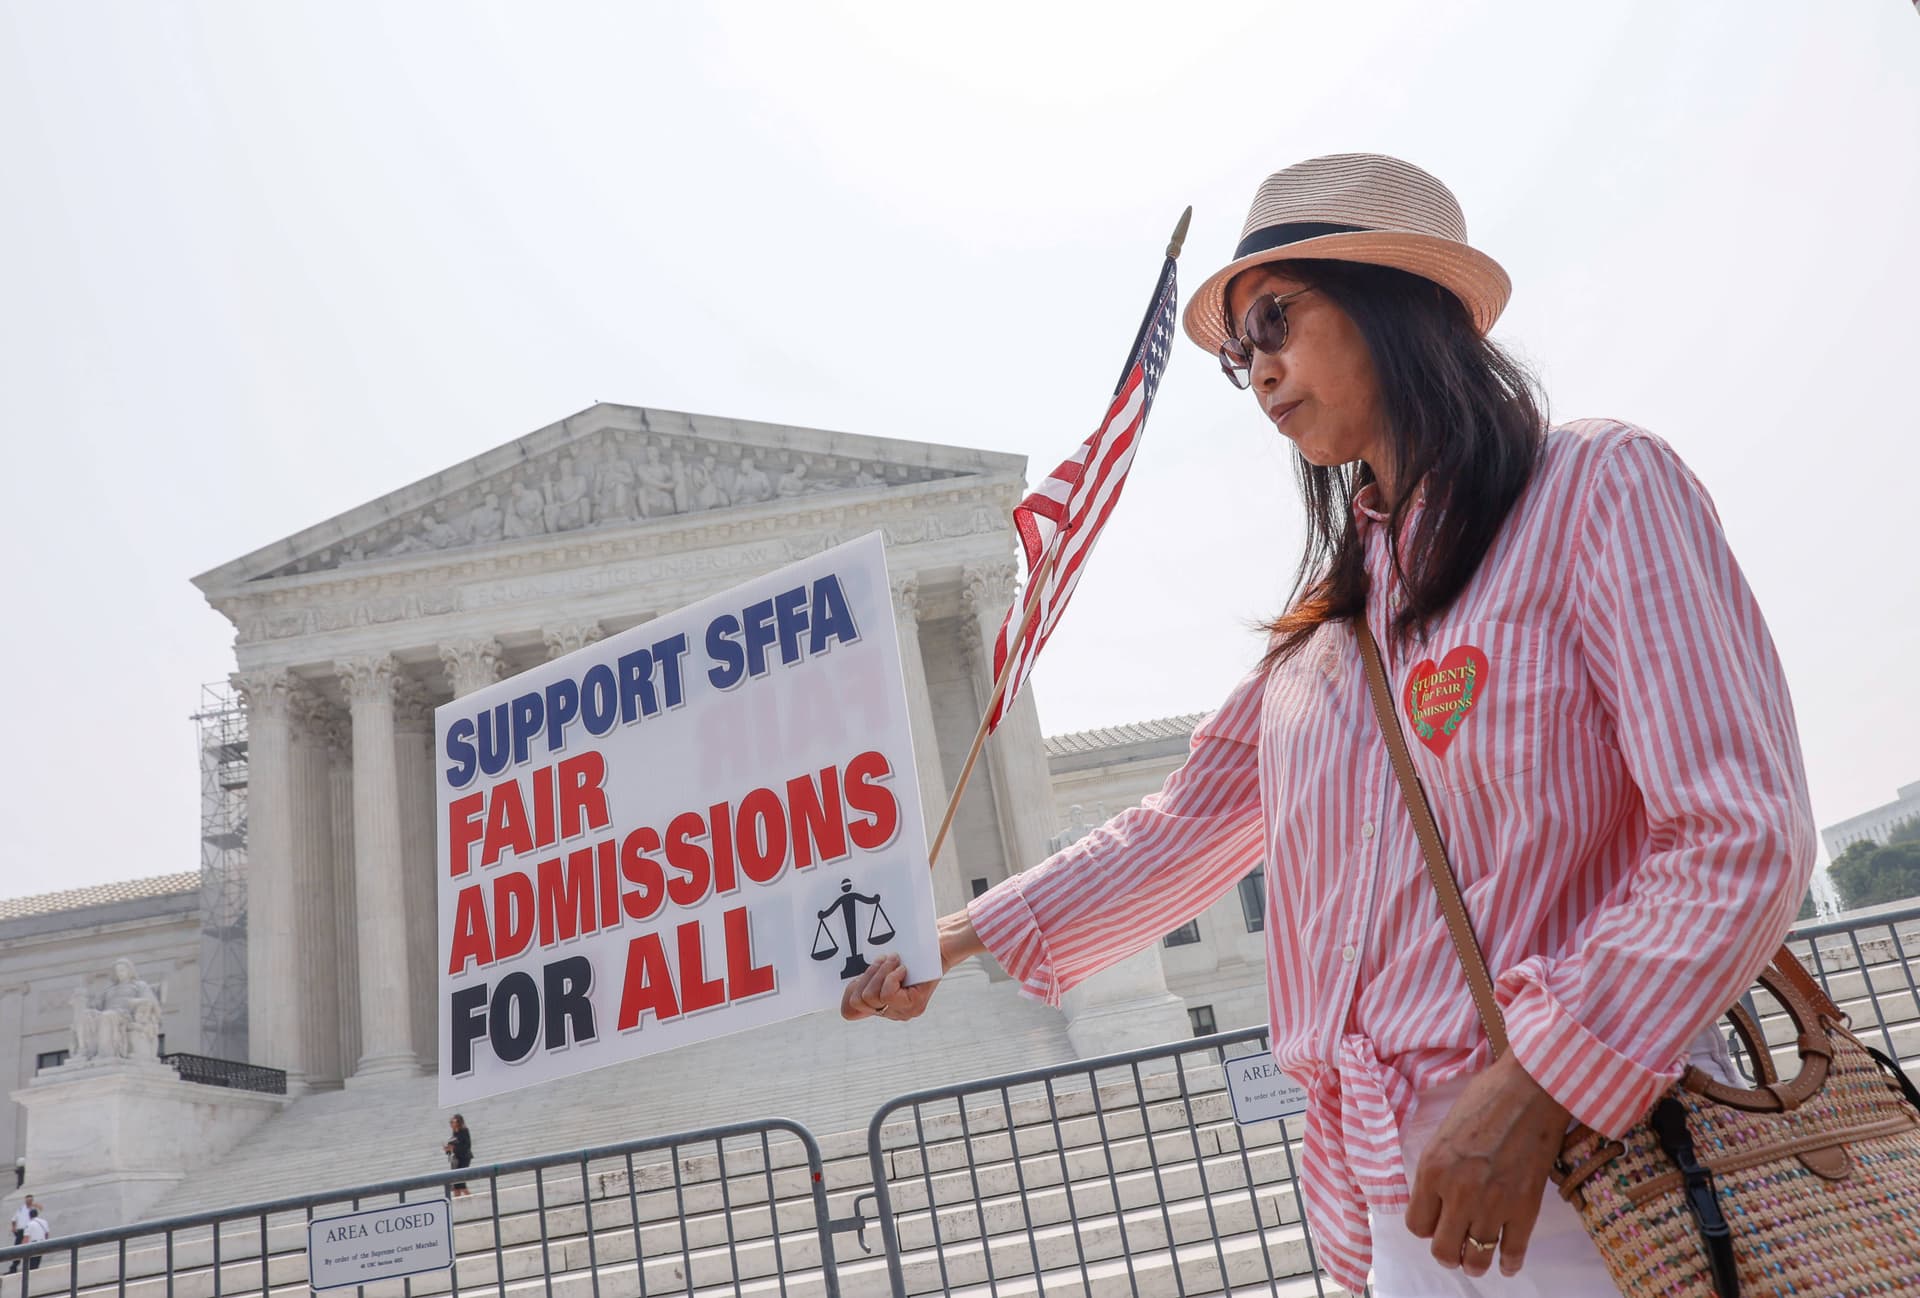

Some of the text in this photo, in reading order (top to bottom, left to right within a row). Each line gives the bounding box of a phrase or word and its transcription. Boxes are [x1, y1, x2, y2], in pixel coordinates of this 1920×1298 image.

[648, 551, 728, 578] UNDER
[732, 548, 768, 570] LAW
[446, 574, 859, 789] SUPPORT SFFA
[1412, 664, 1476, 693] STUDENTS
[1421, 683, 1461, 706] for FAIR
[449, 750, 611, 878] FAIR
[448, 751, 900, 977] ADMISSIONS
[451, 906, 777, 1077] FOR ALL
[1243, 1063, 1282, 1082] AREA
[326, 1212, 435, 1243] AREA CLOSED
